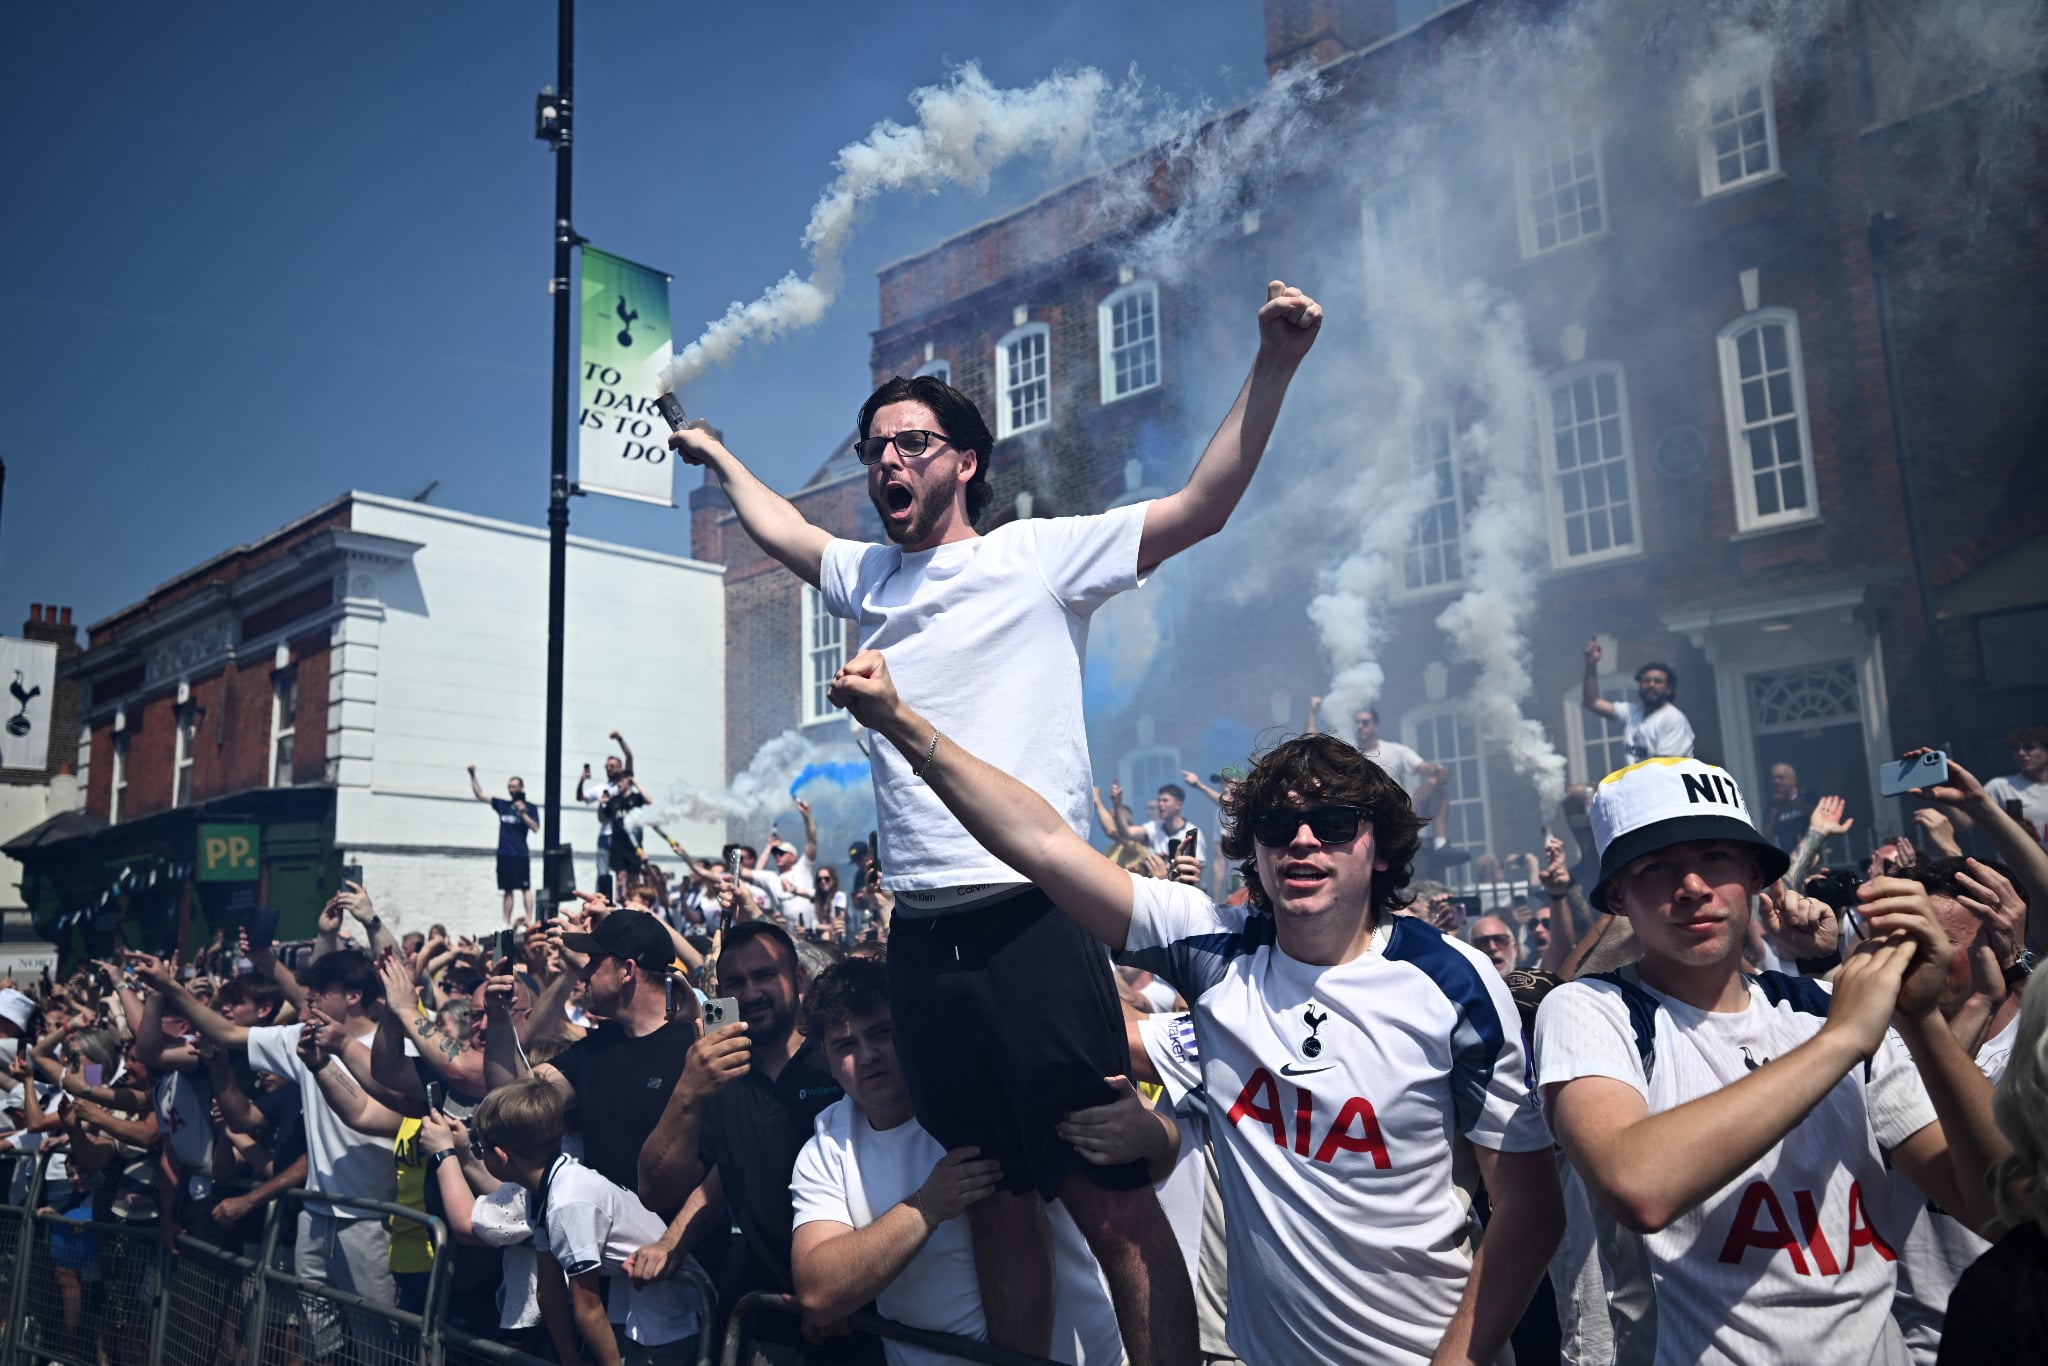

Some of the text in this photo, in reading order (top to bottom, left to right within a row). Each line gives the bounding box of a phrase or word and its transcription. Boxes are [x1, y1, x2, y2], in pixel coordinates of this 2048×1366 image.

[584, 361, 622, 386] TO
[593, 388, 662, 417] DAR
[579, 408, 652, 438] IS TO
[622, 441, 666, 464] DO
[206, 836, 257, 871] PP.
[1226, 1067, 1393, 1170] AIA
[1718, 1180, 1897, 1276] AIA
